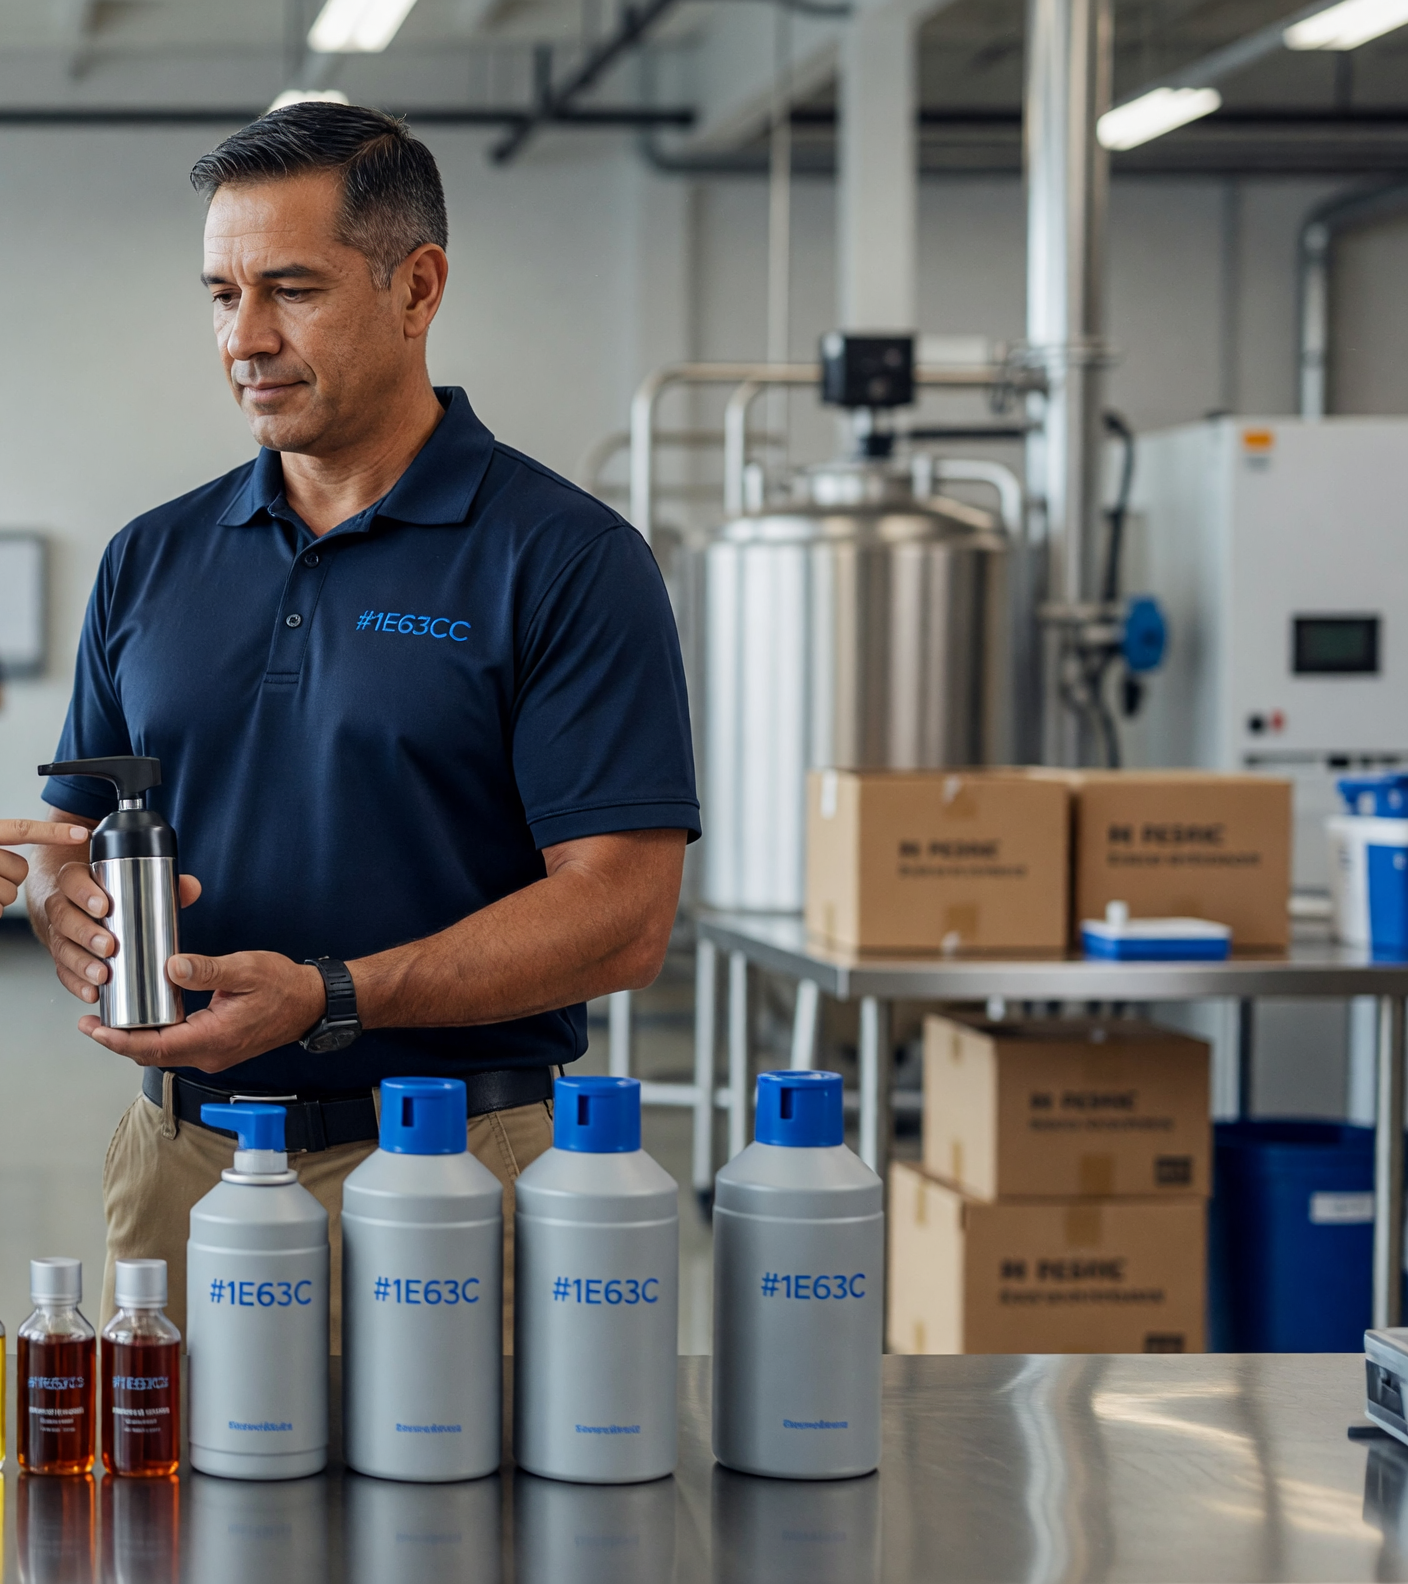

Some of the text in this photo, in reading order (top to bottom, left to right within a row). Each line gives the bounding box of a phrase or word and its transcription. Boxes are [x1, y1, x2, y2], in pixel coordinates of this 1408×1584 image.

[355, 610, 472, 642] #1E63CC
[209, 1278, 312, 1308] #1E63C
[373, 1275, 480, 1306] #1E63C
[552, 1276, 659, 1305] #1E63C
[761, 1272, 866, 1300] #1E63C
